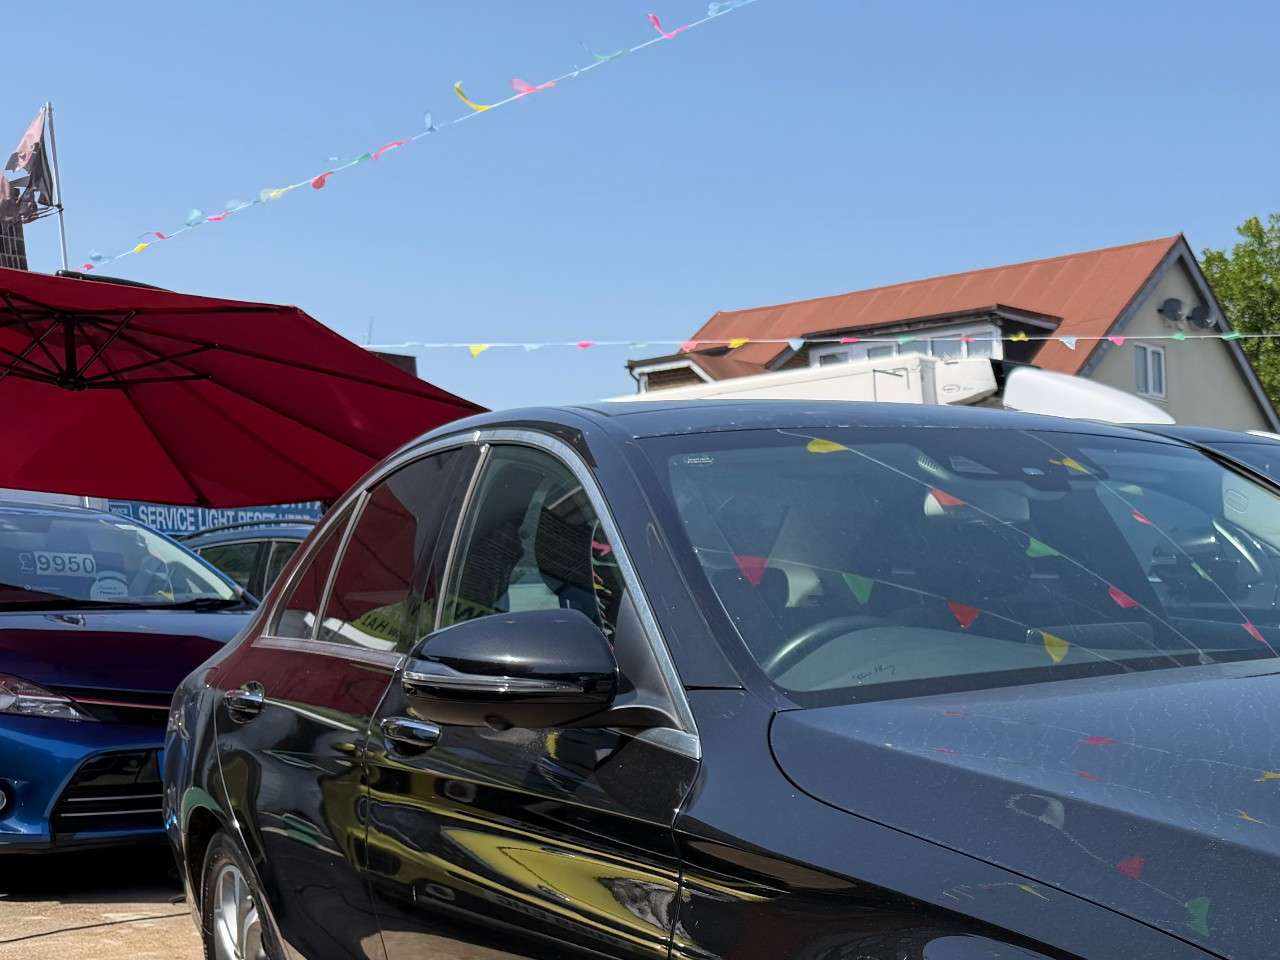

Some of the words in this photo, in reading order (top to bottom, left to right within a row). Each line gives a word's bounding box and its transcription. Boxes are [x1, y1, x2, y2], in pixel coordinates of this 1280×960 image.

[138, 505, 195, 531] SERVICE
[199, 507, 235, 530] LIGHT
[19, 552, 95, 575] £9950
